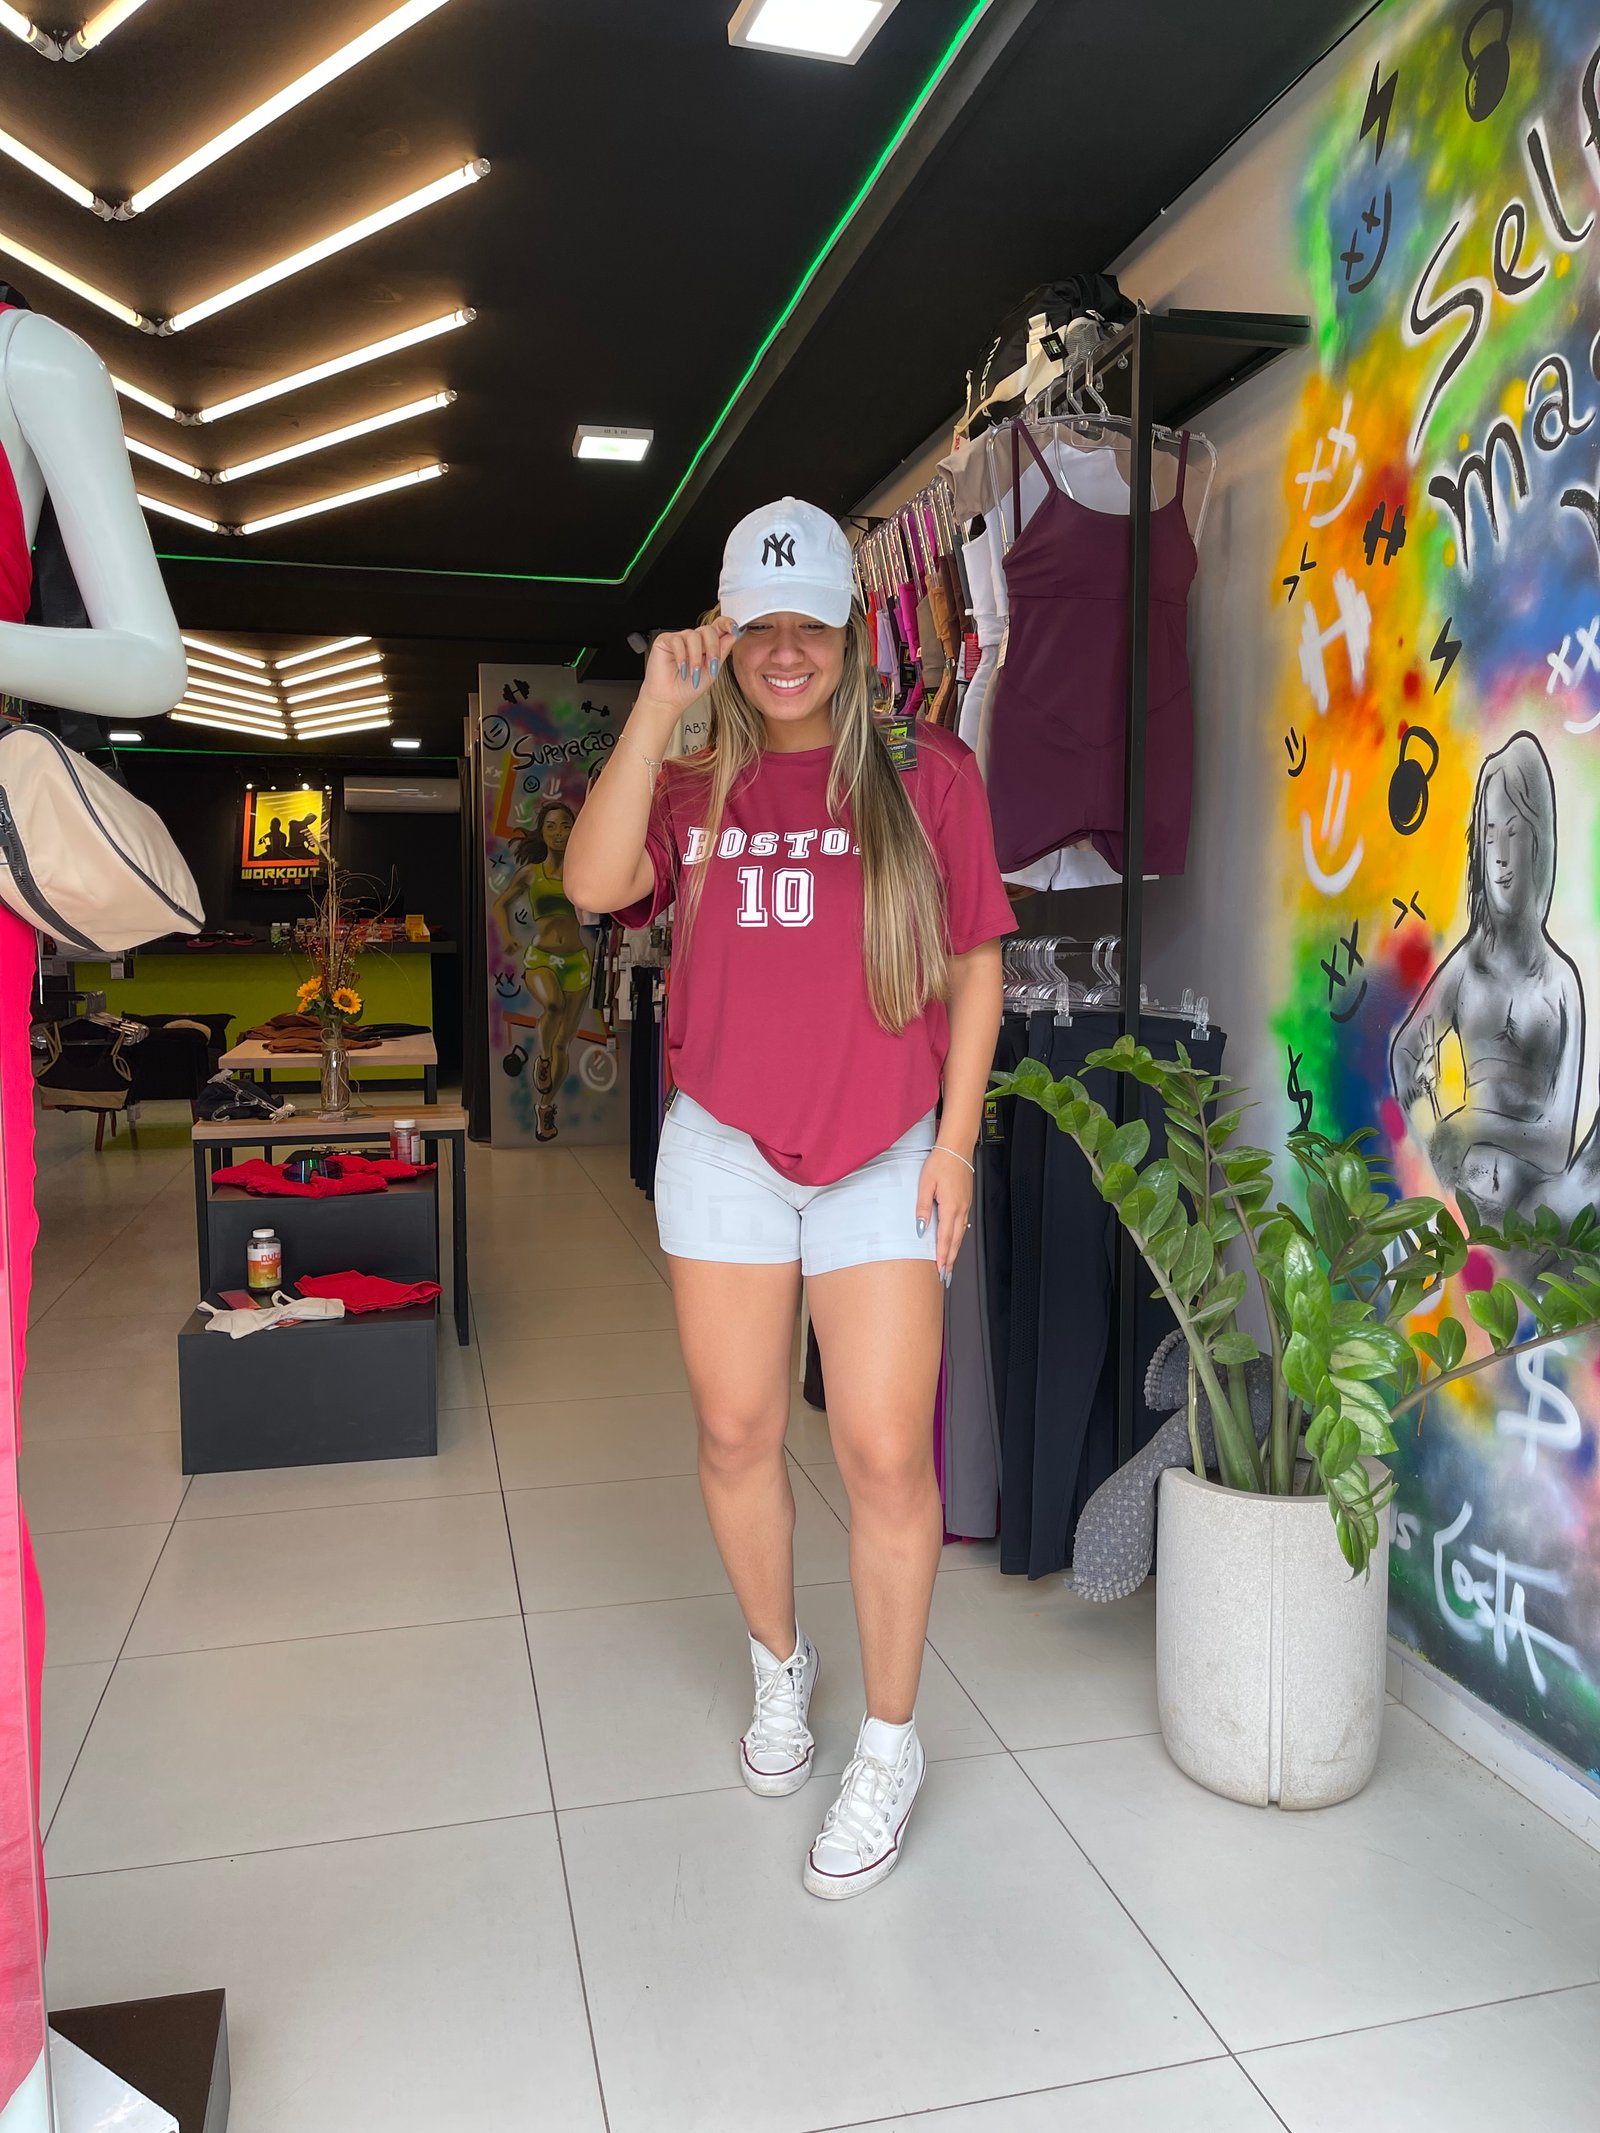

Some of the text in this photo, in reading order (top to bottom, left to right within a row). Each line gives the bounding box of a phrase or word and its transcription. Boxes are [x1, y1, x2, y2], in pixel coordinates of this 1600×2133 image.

[1428, 333, 1600, 570] ma
[682, 826, 862, 865] BOSTO
[241, 867, 320, 880] WORKOUT
[736, 866, 814, 928] 10
